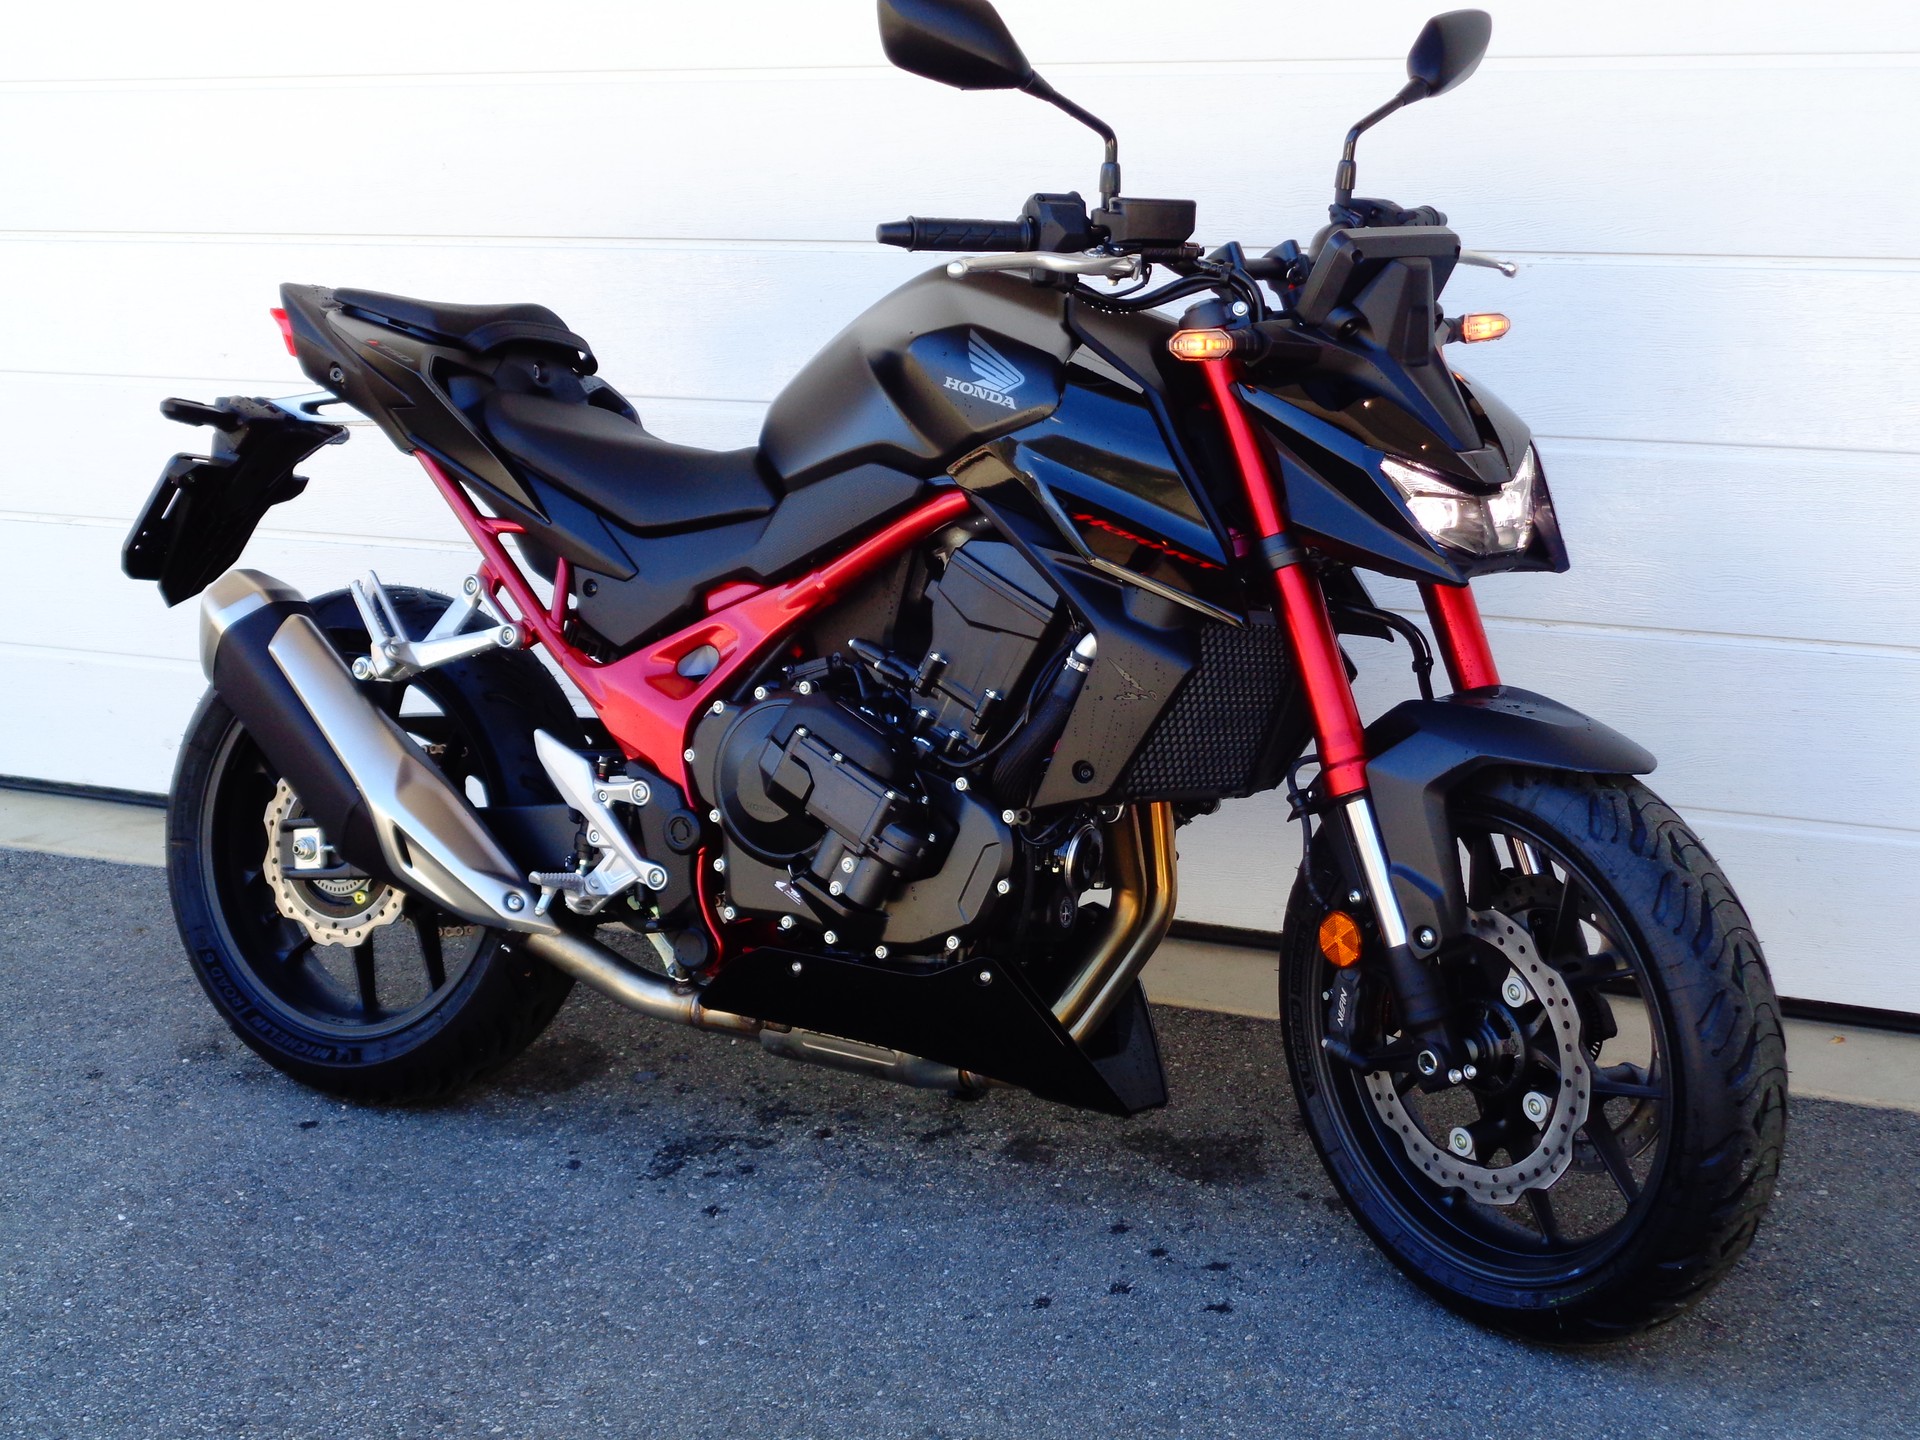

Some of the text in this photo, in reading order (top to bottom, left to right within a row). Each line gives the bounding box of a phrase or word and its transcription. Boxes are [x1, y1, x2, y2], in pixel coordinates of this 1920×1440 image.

[943, 376, 1017, 410] HONDA
[202, 952, 332, 1060] MICHELIN ROAD 6
